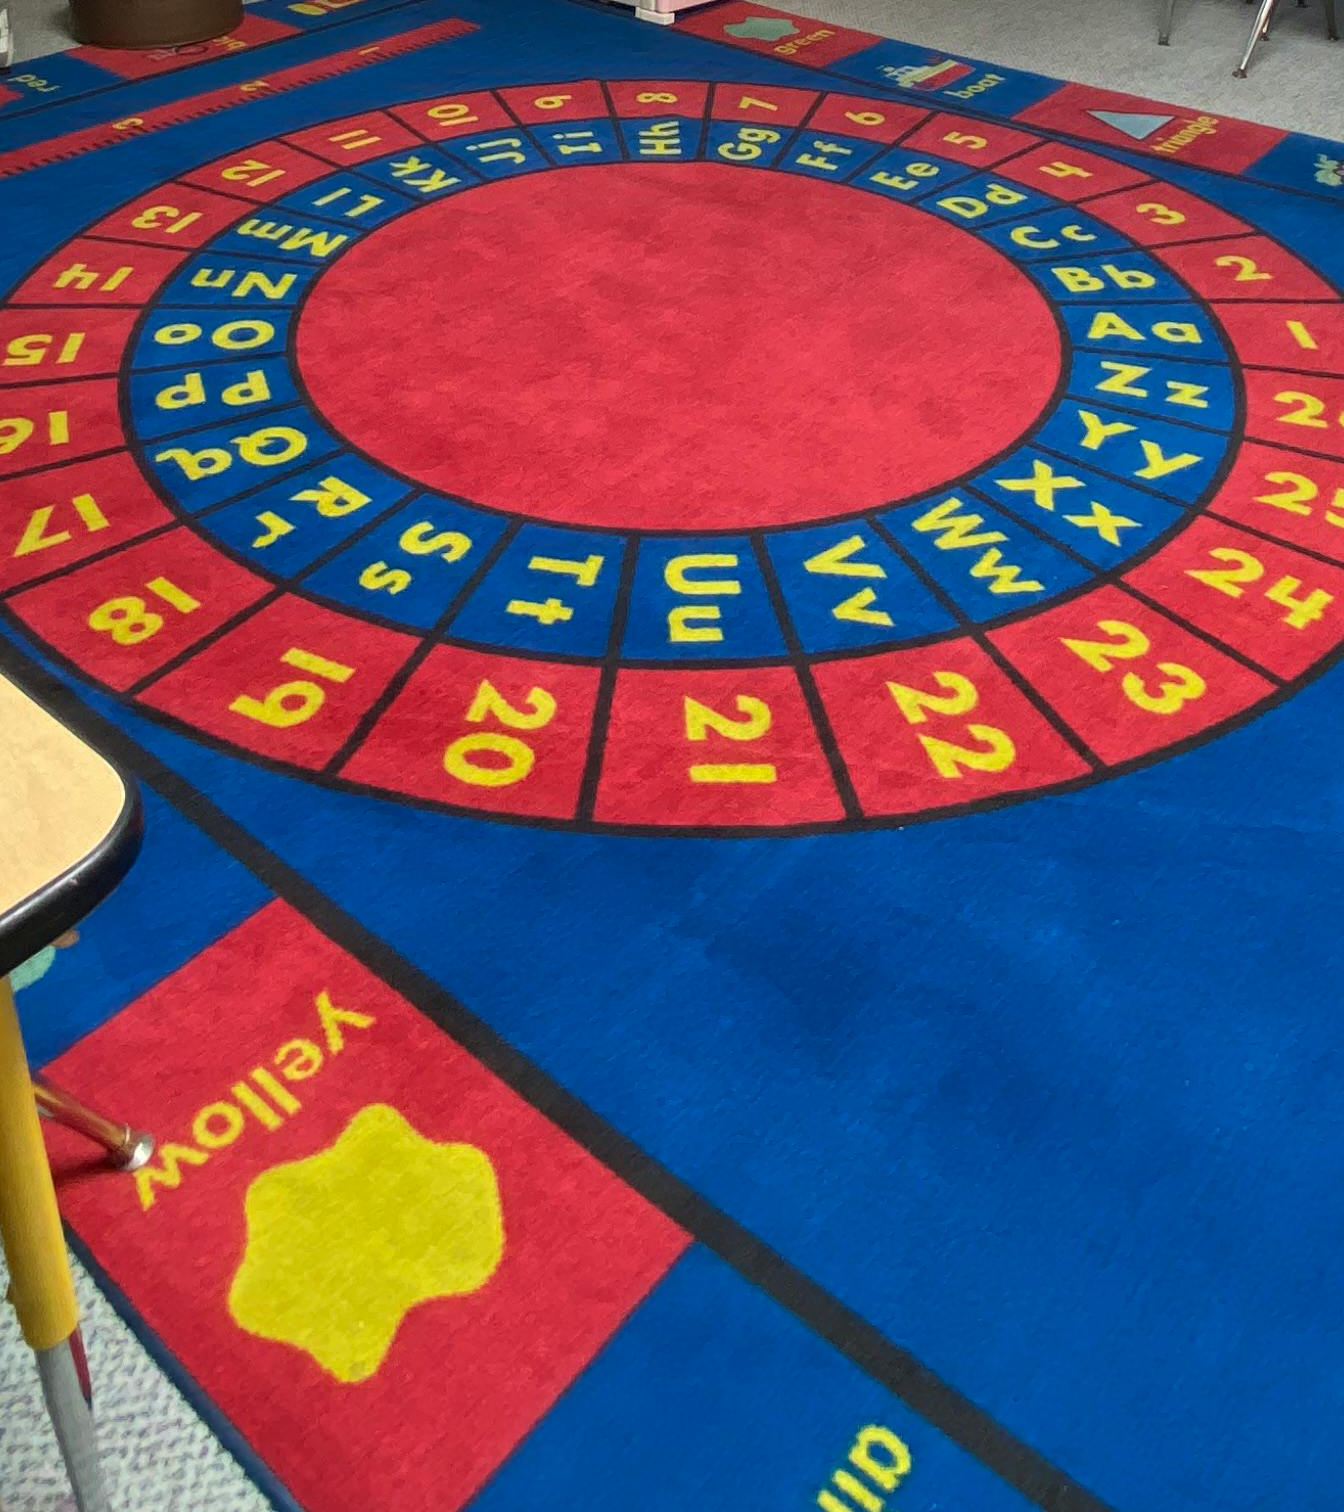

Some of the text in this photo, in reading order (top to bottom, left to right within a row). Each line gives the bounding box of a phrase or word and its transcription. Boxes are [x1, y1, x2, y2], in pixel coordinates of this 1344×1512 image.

[774, 27, 835, 56] green
[8, 75, 59, 92] red
[637, 93, 677, 103] 8
[944, 73, 1008, 100] boat
[428, 104, 478, 126] 10
[535, 95, 571, 108] 9
[740, 97, 777, 110] 7
[113, 118, 143, 129] 3
[845, 112, 884, 125] 6
[1149, 114, 1220, 154] triangle
[329, 130, 381, 149] 11
[466, 139, 525, 163] Jj
[553, 132, 601, 154] Ii
[639, 122, 681, 154] Hh
[718, 128, 780, 160] Gg
[943, 132, 987, 149] 5
[796, 141, 851, 170] Ff
[1039, 162, 1092, 177] 4
[222, 160, 285, 186] 12
[390, 157, 461, 192] Kk
[870, 163, 939, 190] Ee
[313, 188, 383, 216] Ll
[937, 184, 1027, 218] Dd
[1137, 204, 1185, 224] 3
[132, 206, 202, 233] 13
[237, 219, 348, 257] Mm
[1011, 225, 1096, 248] Cc
[54, 264, 133, 290] 14
[191, 269, 297, 299] Nn
[1052, 265, 1155, 292] Bb
[1215, 255, 1275, 282] 2
[155, 320, 274, 349] Oo
[1088, 312, 1202, 343] Aa
[1286, 319, 1320, 350] 1
[3, 333, 85, 365] 15
[156, 370, 270, 409] Pp
[1095, 361, 1208, 408] Zz
[156, 427, 307, 480] Qq
[1078, 410, 1202, 479] Yy
[253, 476, 372, 547] Rr
[993, 459, 1144, 548] Xx
[14, 494, 109, 556] 17
[360, 522, 471, 594] Ss
[910, 497, 1046, 594] Ww
[507, 555, 604, 624] Tt
[804, 535, 893, 626] Vv
[1186, 548, 1333, 629] 24
[89, 577, 200, 644] 18
[665, 554, 741, 641] Uu
[1062, 620, 1205, 714] 23
[229, 648, 354, 727] 19
[444, 680, 556, 786] 20
[685, 696, 776, 783] 21
[887, 672, 1015, 778] 22
[131, 989, 377, 1211] yellow
